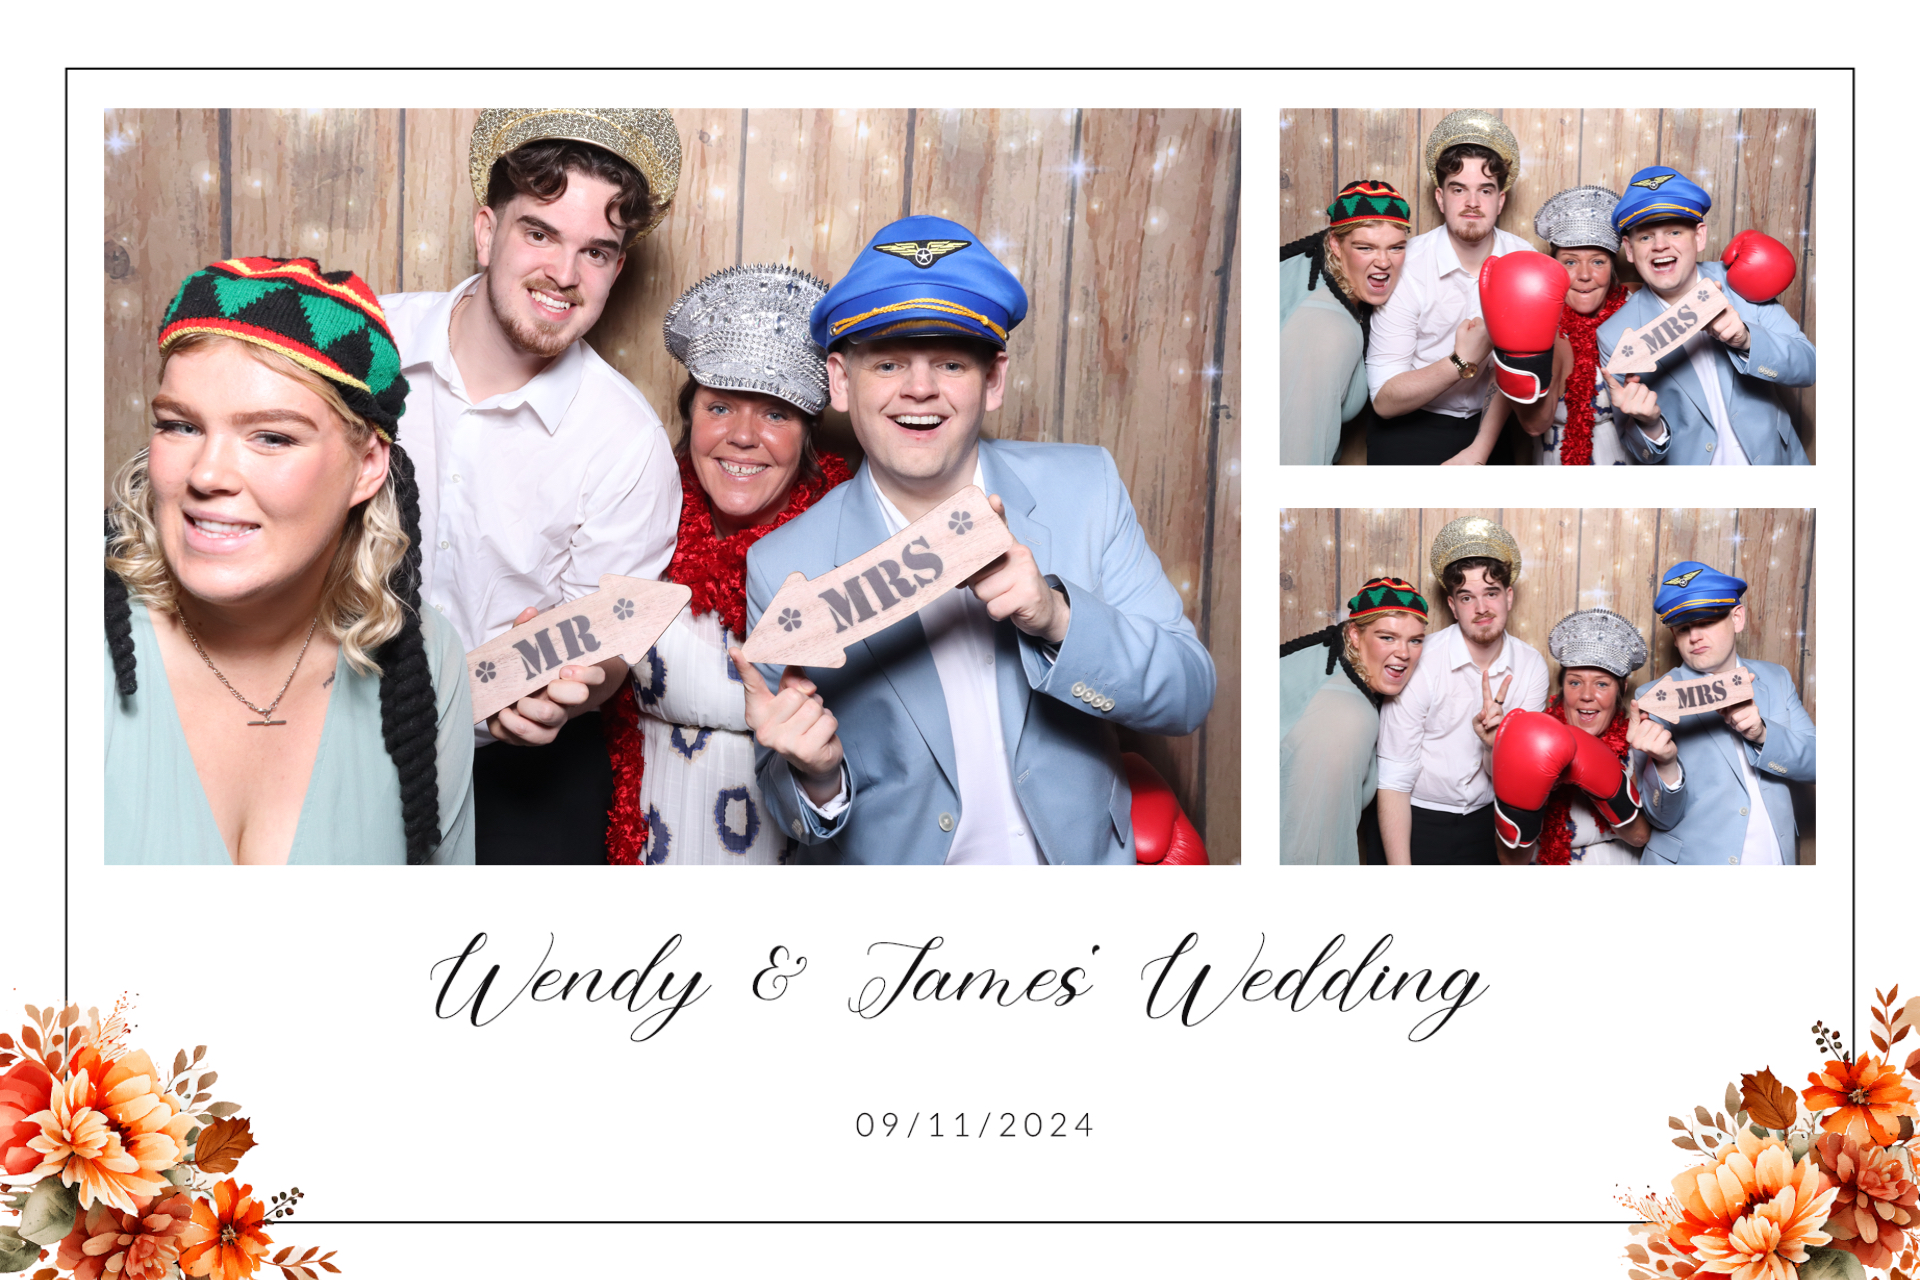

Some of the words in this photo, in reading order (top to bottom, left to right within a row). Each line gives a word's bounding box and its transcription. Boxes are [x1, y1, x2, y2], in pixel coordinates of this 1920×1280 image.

[1641, 305, 1698, 355] MRS
[817, 535, 944, 634] MRS
[512, 614, 601, 681] MR
[1676, 680, 1727, 709] MRS
